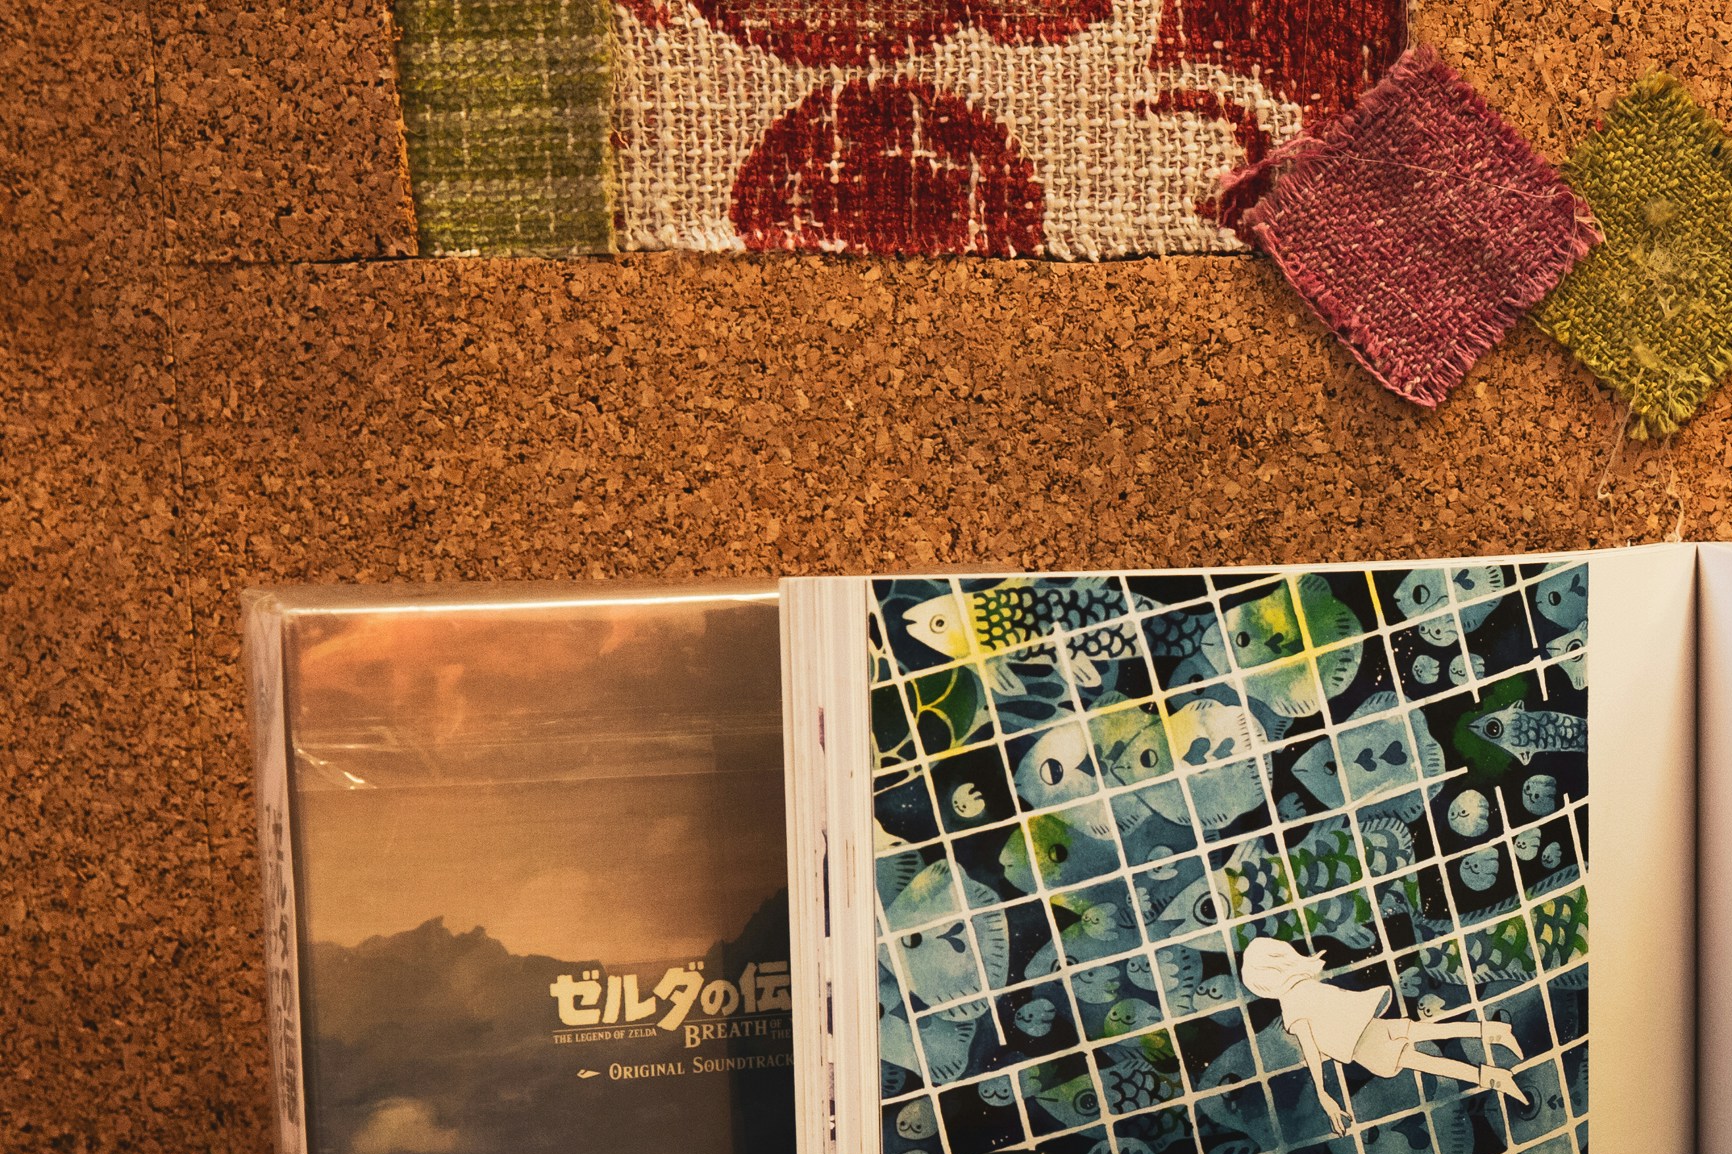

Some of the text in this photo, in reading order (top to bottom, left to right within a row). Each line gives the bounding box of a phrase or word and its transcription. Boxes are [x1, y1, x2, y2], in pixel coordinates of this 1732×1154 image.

[550, 961, 792, 1031] ゼルダの伝
[553, 1028, 657, 1044] THE LEGEND OF ZELDA
[684, 1020, 768, 1048] BREATH
[609, 1053, 794, 1080] ORIGINAL SOUNDTRACK
